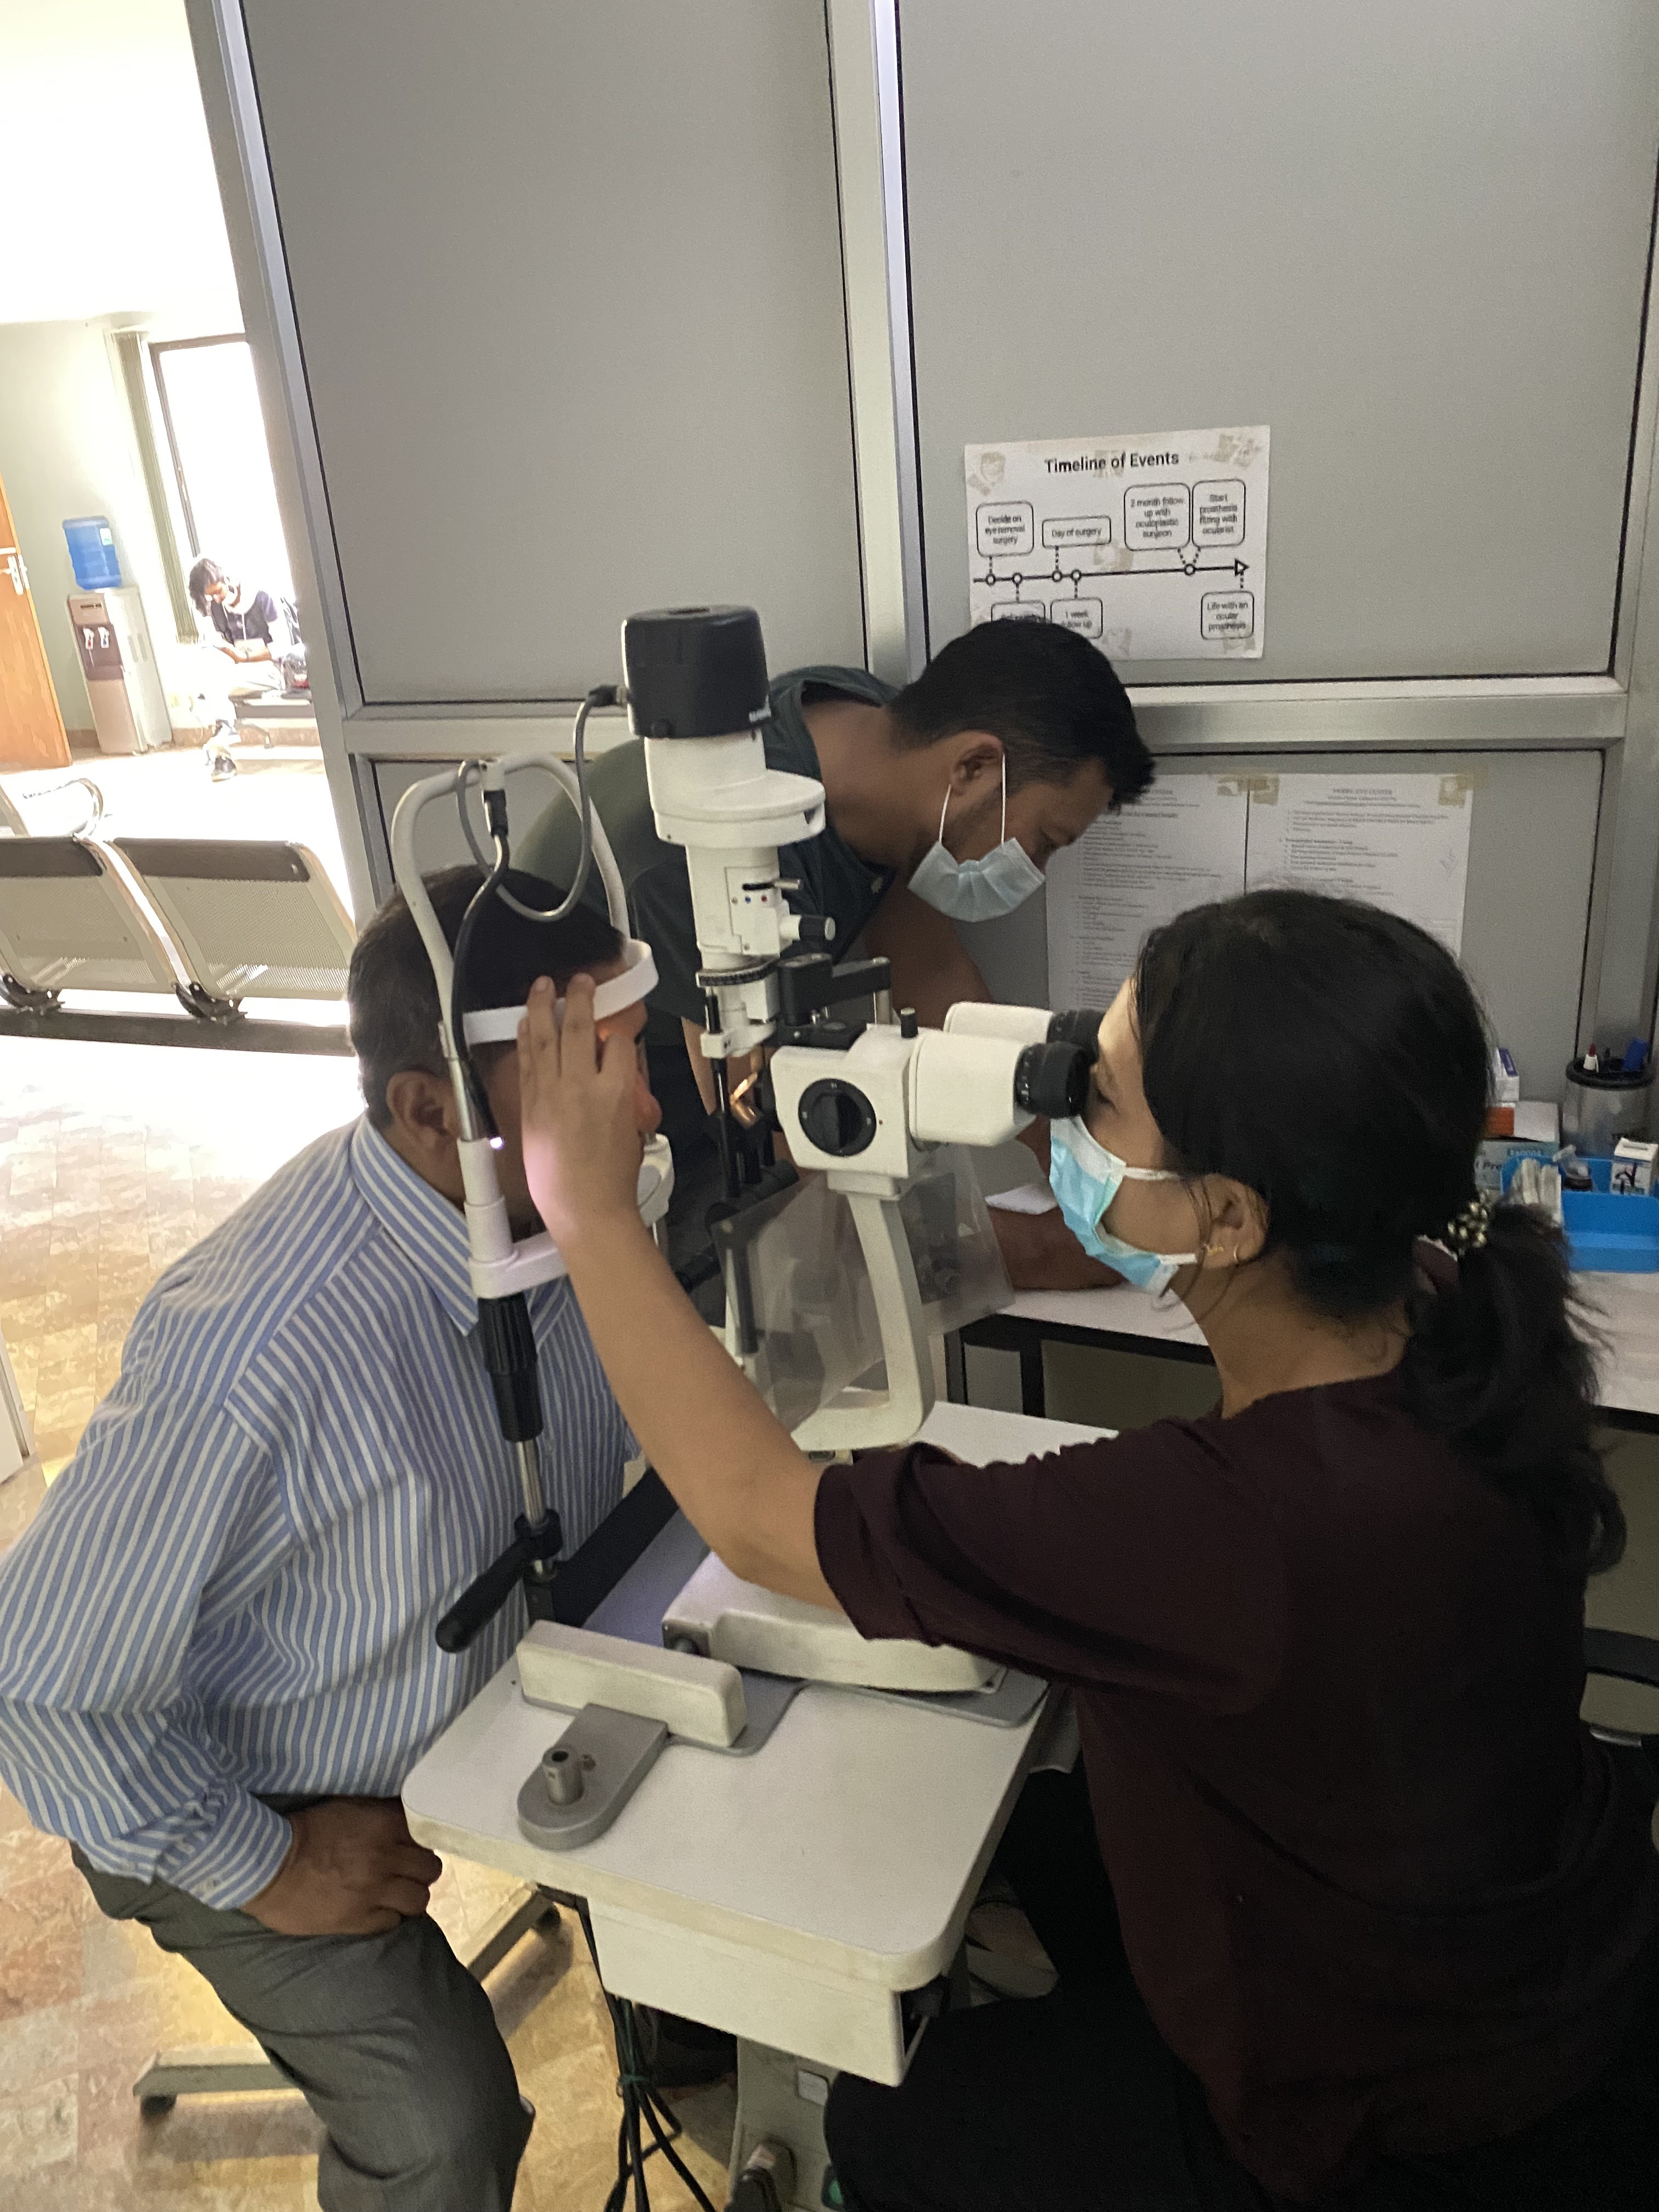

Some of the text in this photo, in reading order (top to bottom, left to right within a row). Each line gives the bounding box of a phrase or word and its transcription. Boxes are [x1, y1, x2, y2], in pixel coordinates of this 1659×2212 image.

[1045, 452, 1179, 473] Timeline of Events
[1137, 498, 1160, 506] month
[988, 514, 1012, 523] Decide
[997, 524, 1025, 534] removal
[1052, 527, 1102, 539] Day of surgery
